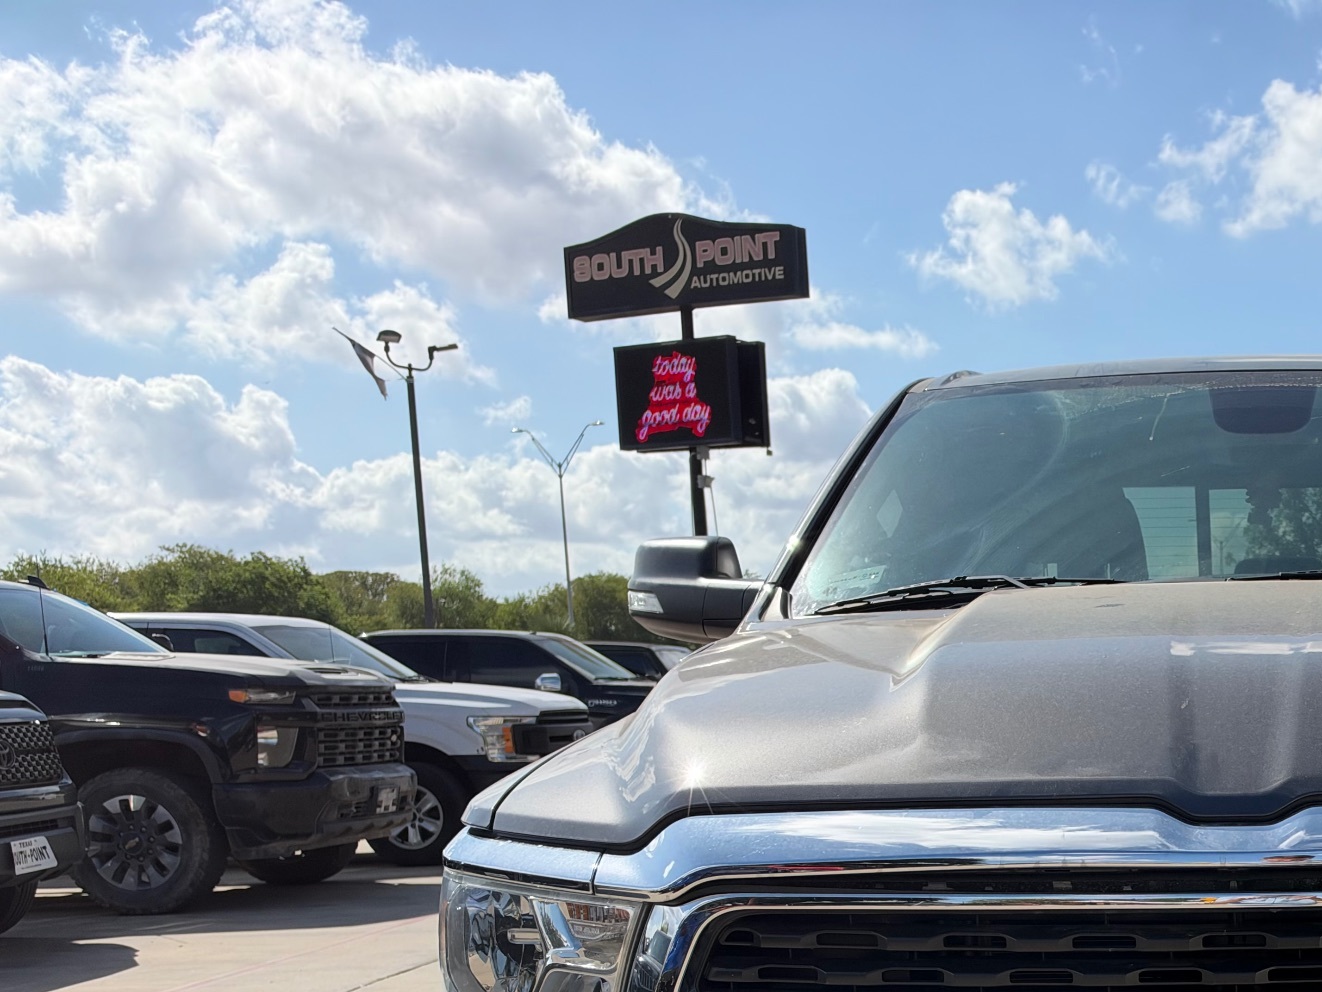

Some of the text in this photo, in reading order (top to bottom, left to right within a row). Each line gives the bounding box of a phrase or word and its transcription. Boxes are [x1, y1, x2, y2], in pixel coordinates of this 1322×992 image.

[573, 231, 780, 283] SOUTH POINT
[690, 266, 785, 289] AUTOMOTIVE
[652, 354, 696, 382] today
[649, 382, 697, 401] was a
[639, 402, 711, 440] good day
